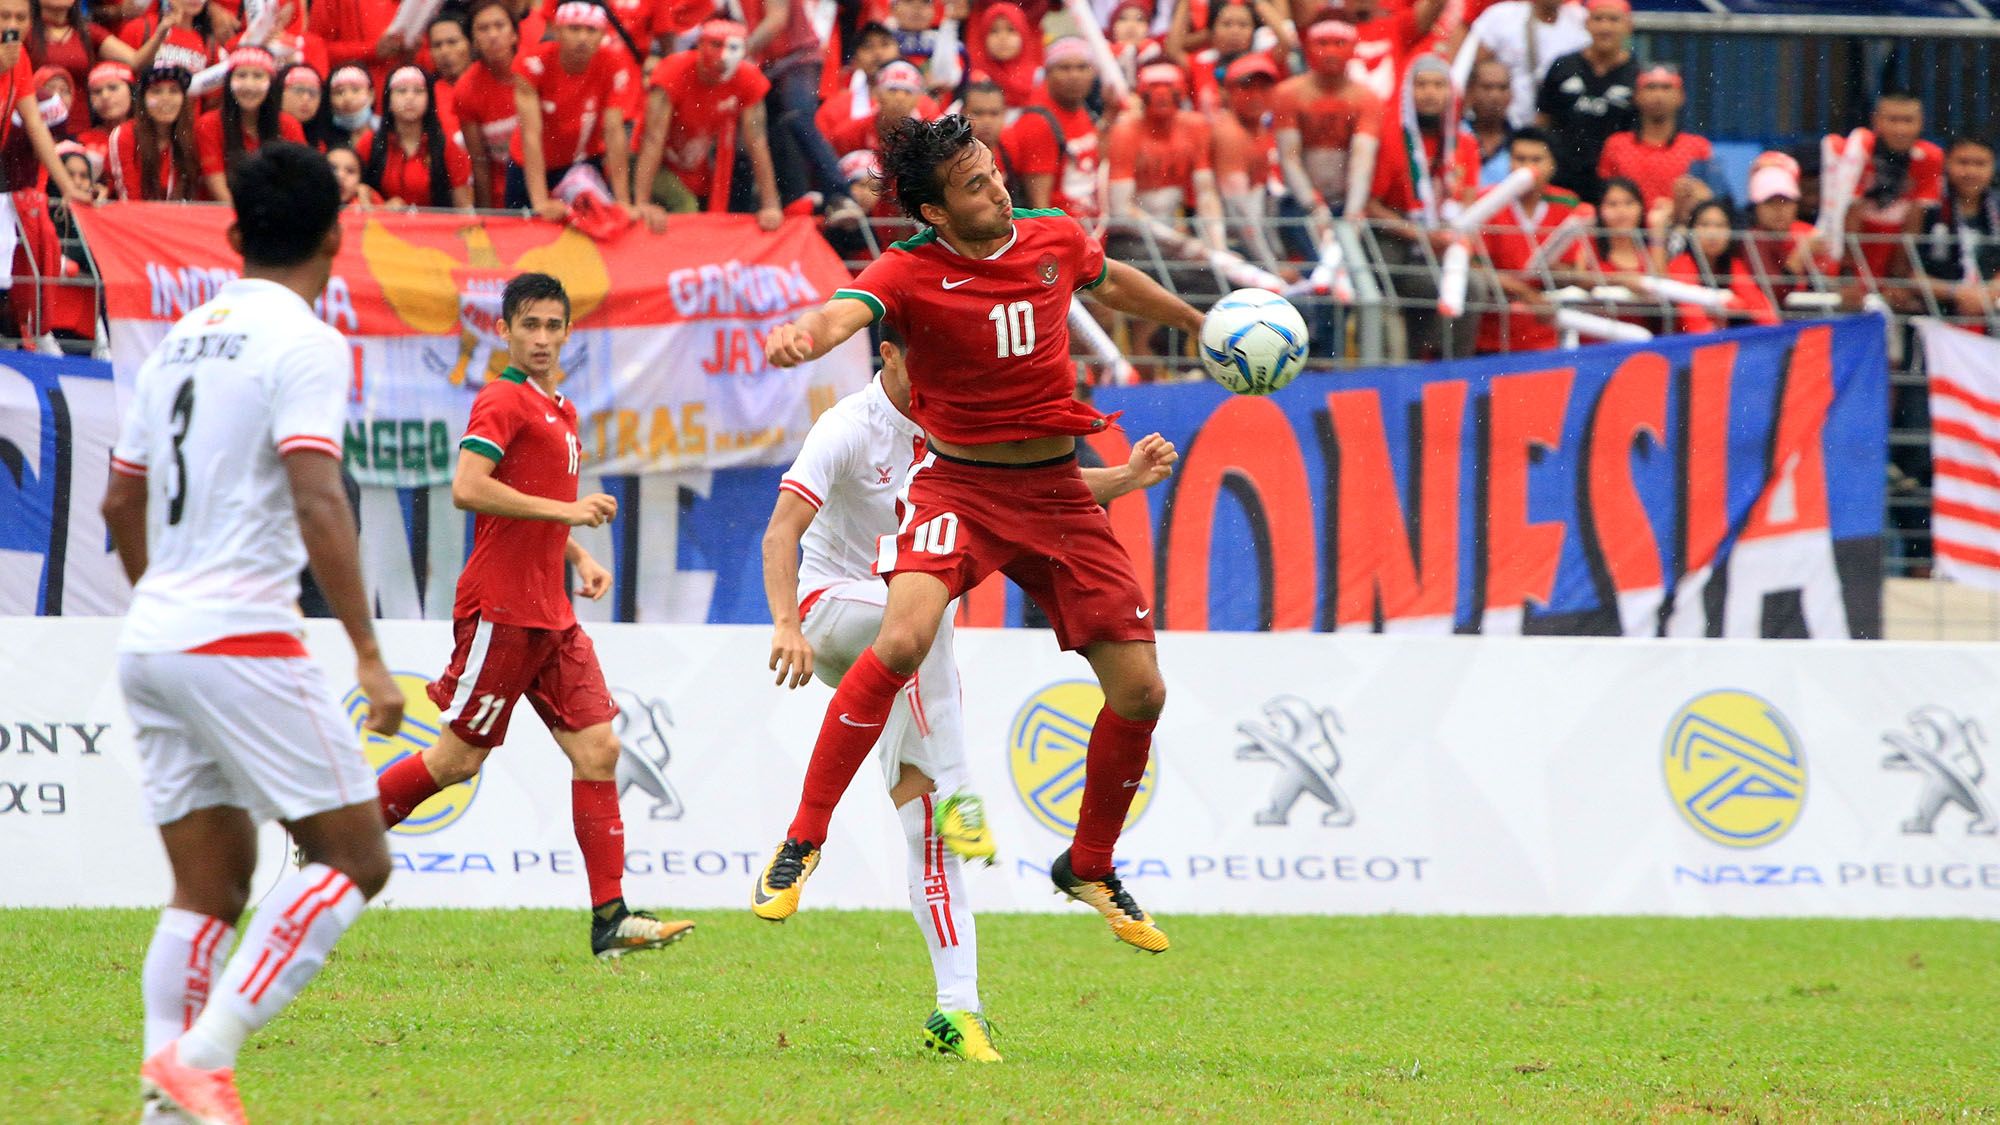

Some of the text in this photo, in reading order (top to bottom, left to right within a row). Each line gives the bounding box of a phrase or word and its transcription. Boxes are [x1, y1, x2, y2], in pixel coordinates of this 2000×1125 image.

[702, 326, 784, 376] JAY
[988, 300, 1036, 359] 10
[164, 374, 196, 527] 3
[343, 420, 450, 471] NGGO
[565, 431, 581, 476] 11
[912, 511, 959, 556] 10
[467, 694, 507, 737] 11
[390, 849, 760, 876] AZA PEGEOT
[1188, 854, 1431, 881] PEUGEOT
[1674, 864, 1824, 886] NAZA
